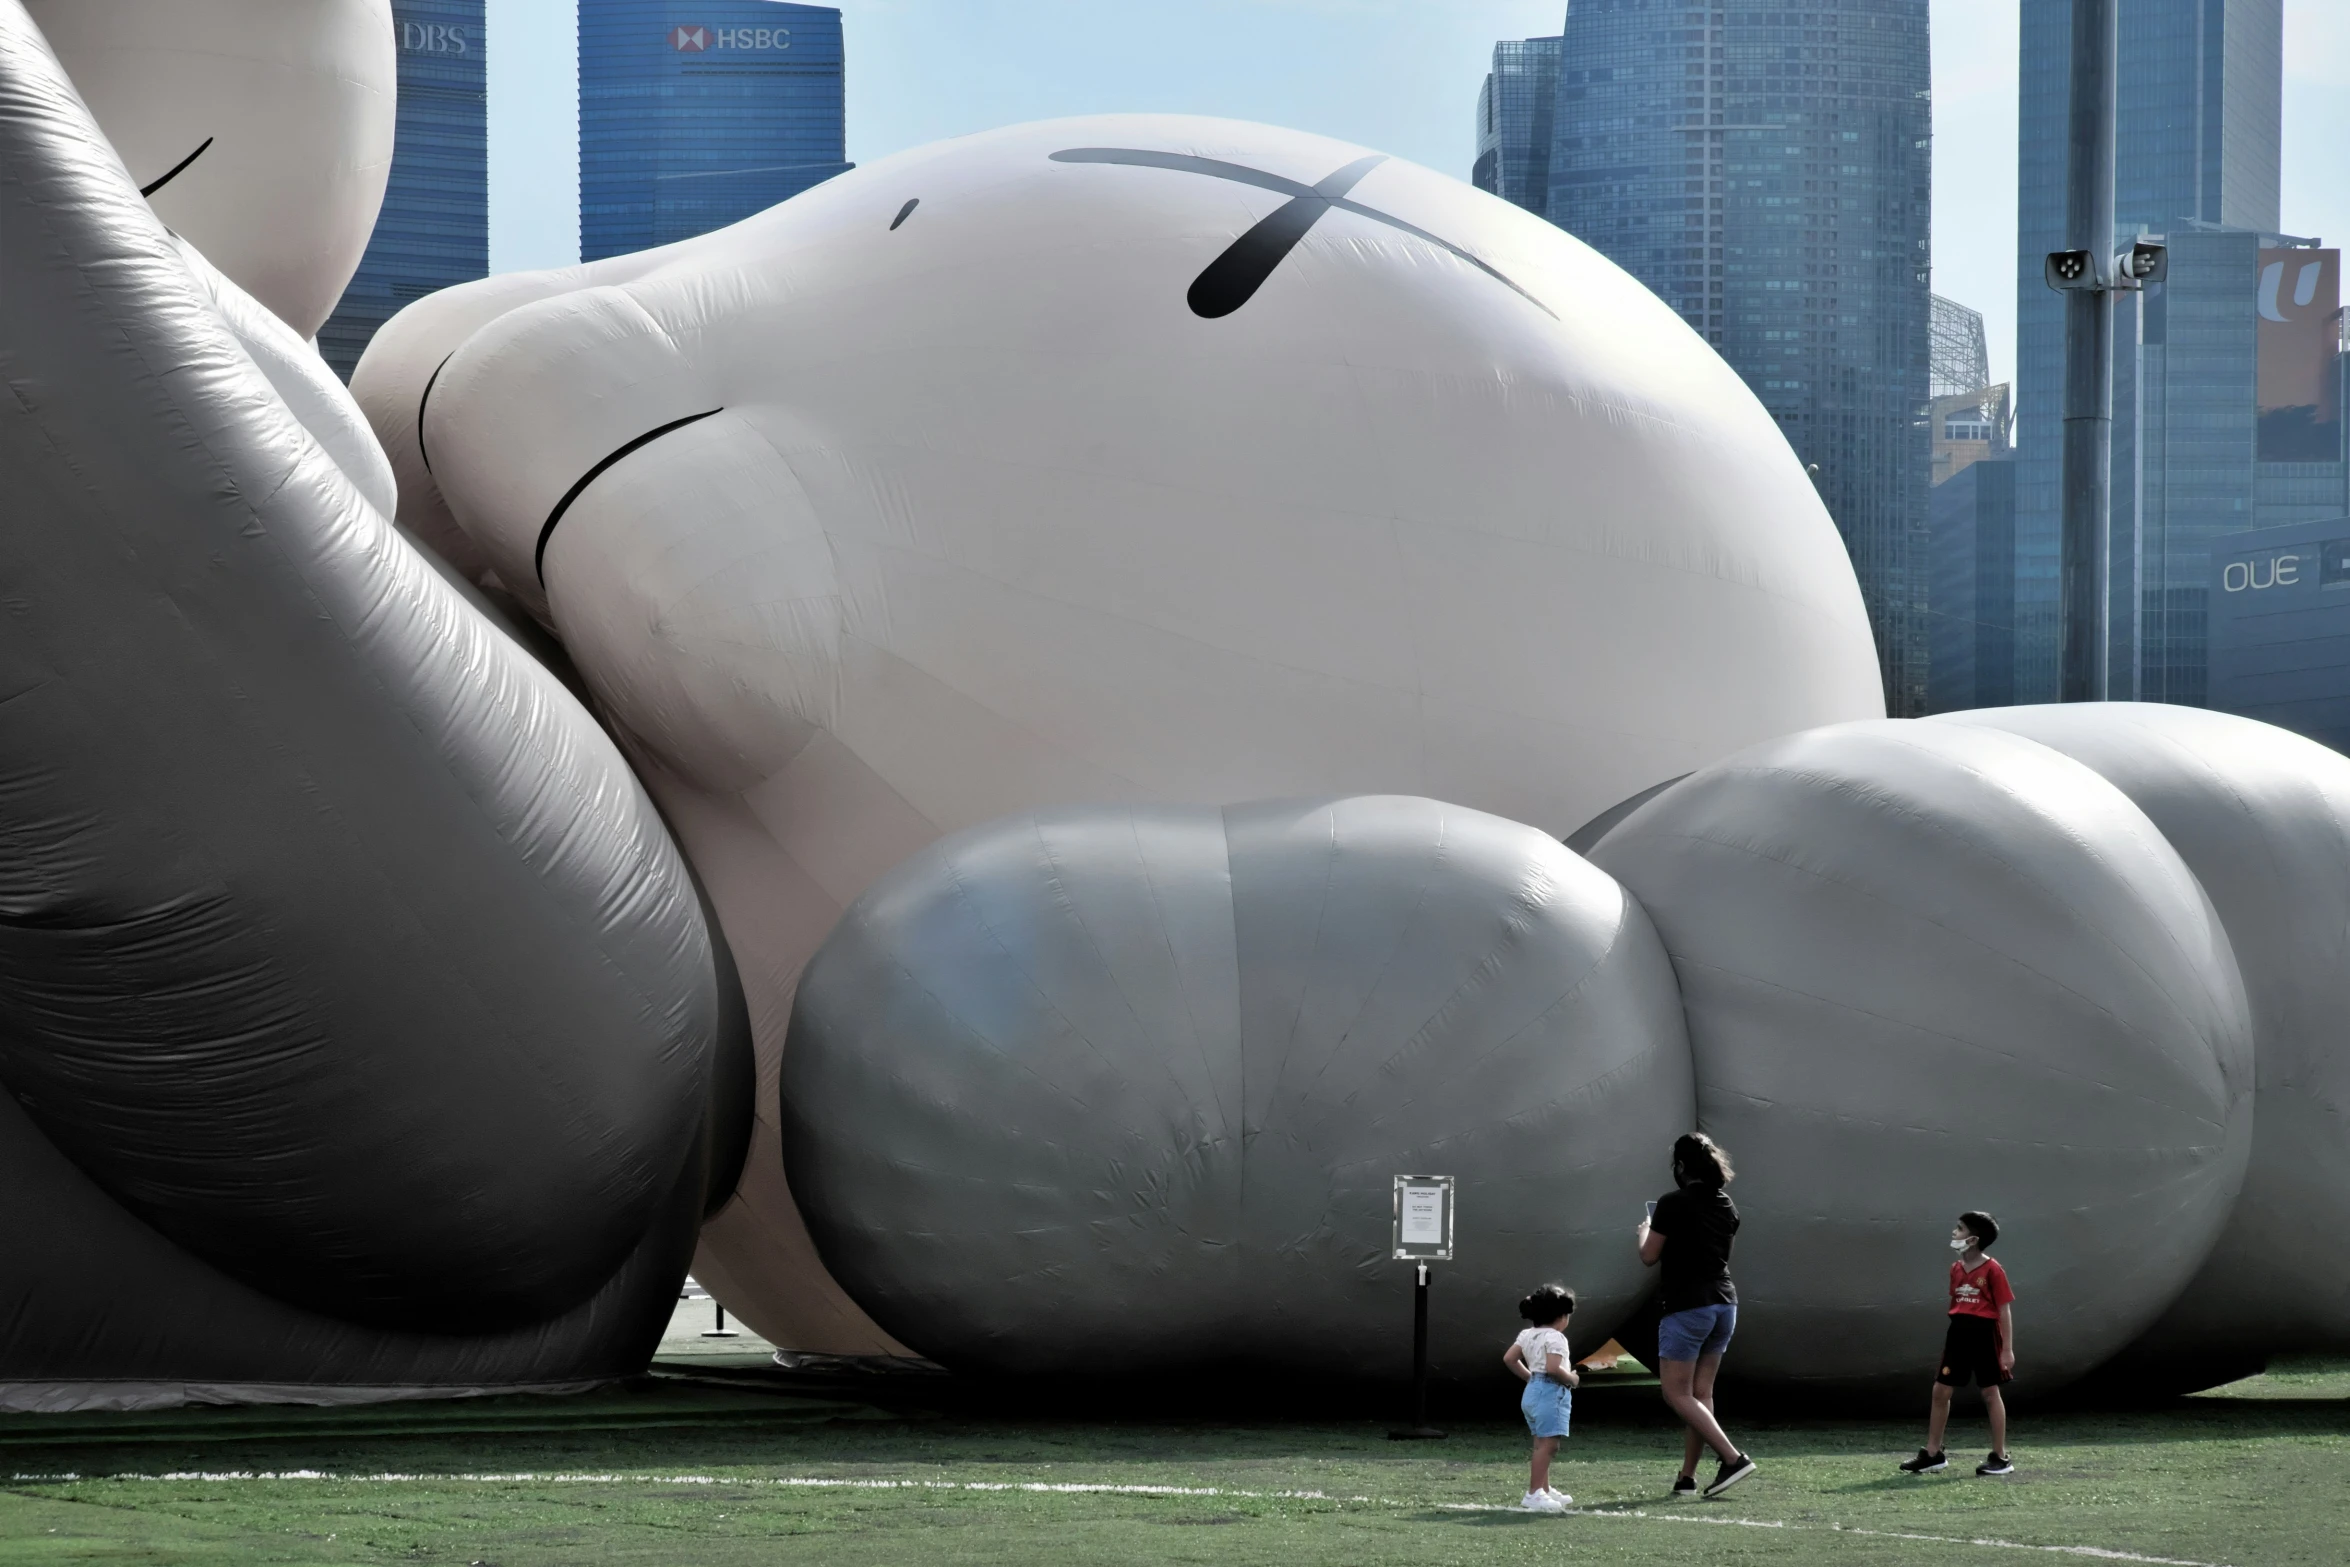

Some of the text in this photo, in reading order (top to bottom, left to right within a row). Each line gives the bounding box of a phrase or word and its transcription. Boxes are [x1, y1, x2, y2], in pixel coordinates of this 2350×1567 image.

[403, 22, 467, 54] DBS
[717, 28, 791, 50] HSBC
[2223, 555, 2300, 592] OUE
